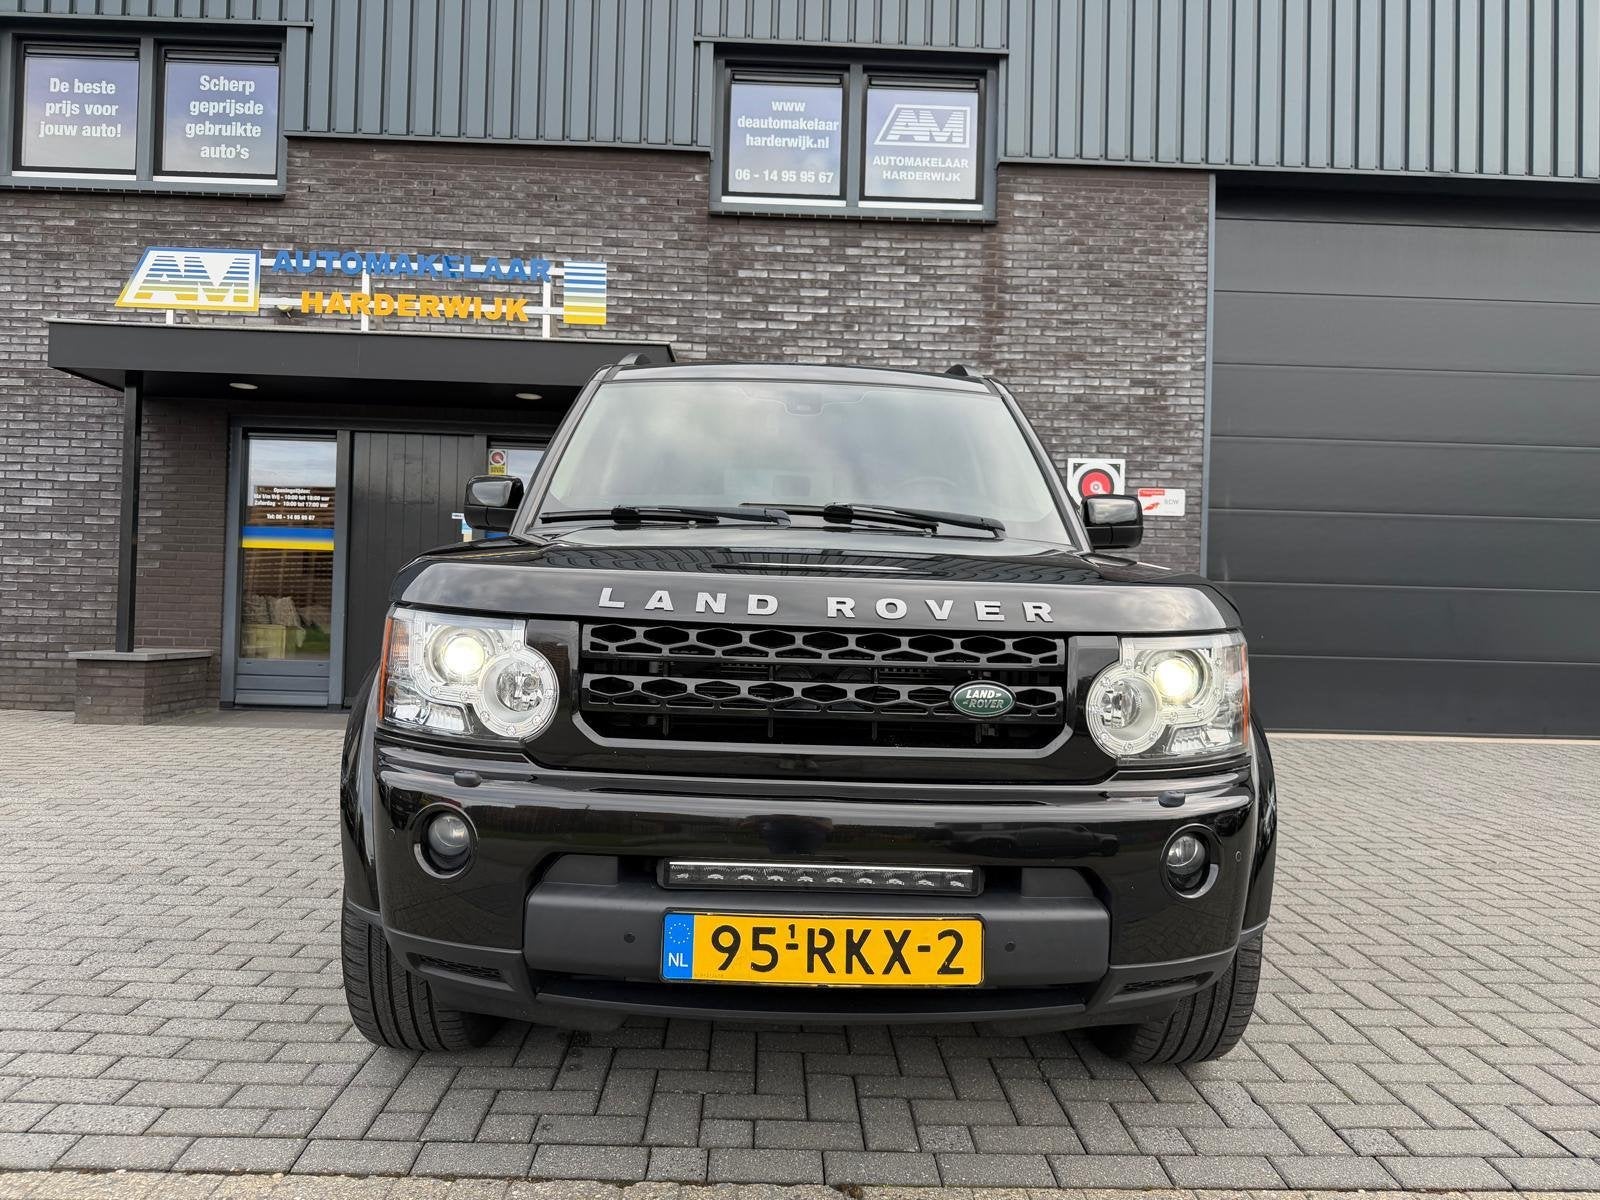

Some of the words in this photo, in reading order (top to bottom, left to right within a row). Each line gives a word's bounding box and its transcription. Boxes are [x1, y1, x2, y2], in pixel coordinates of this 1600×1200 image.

[50, 78, 69, 93] De
[74, 78, 116, 94] beste
[200, 75, 255, 95] Scherp
[45, 100, 80, 117] prijs
[85, 103, 119, 116] voor
[190, 99, 264, 117] geprijsde
[771, 101, 806, 112] www
[39, 121, 78, 137] jouw
[82, 123, 122, 137] auto!
[185, 121, 262, 138] gebruikte
[737, 115, 839, 131] deautomakelaar
[885, 109, 965, 143] AM
[745, 135, 830, 150] harderwijk.nl
[200, 144, 250, 160] auto's
[872, 156, 969, 169] AUTOMAKELAAR
[735, 168, 751, 181] 06
[764, 169, 778, 182] 14
[782, 170, 797, 183] 95
[800, 171, 815, 183] 95
[819, 171, 834, 184] 67
[883, 170, 961, 182] HARDERWIJK
[272, 249, 552, 282] AUTOMAKELAAR
[133, 255, 252, 303] AM
[301, 290, 529, 322] HARDERWIJK
[598, 587, 779, 616] LAND
[826, 595, 1055, 623] ROVER
[668, 952, 689, 968] NL
